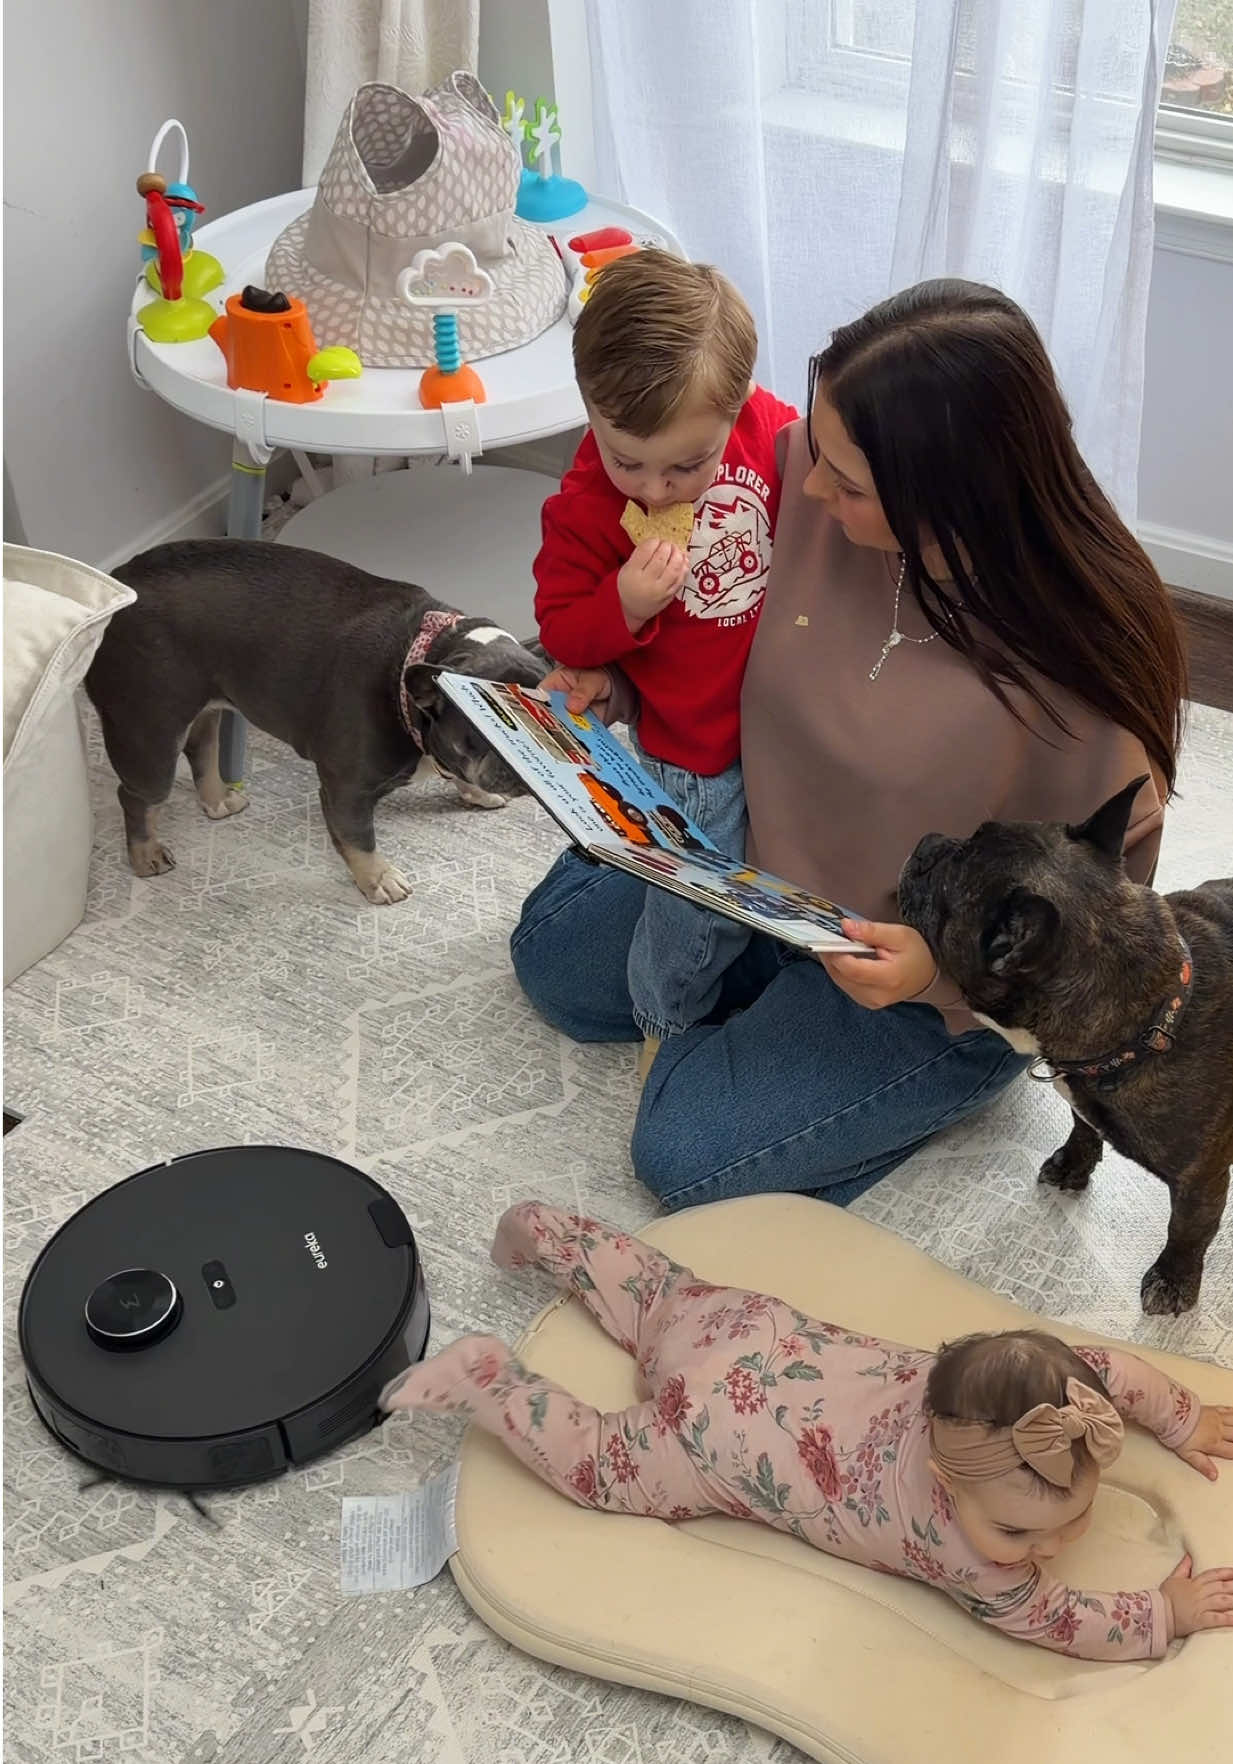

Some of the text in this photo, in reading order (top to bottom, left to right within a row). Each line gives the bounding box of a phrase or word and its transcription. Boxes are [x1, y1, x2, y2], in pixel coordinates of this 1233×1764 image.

[713, 463, 770, 502] PLORER
[717, 613, 747, 628] LOCAL
[530, 767, 544, 777] of
[544, 780, 557, 791] all
[570, 808, 593, 831] Look
[303, 1231, 328, 1270] eureka
